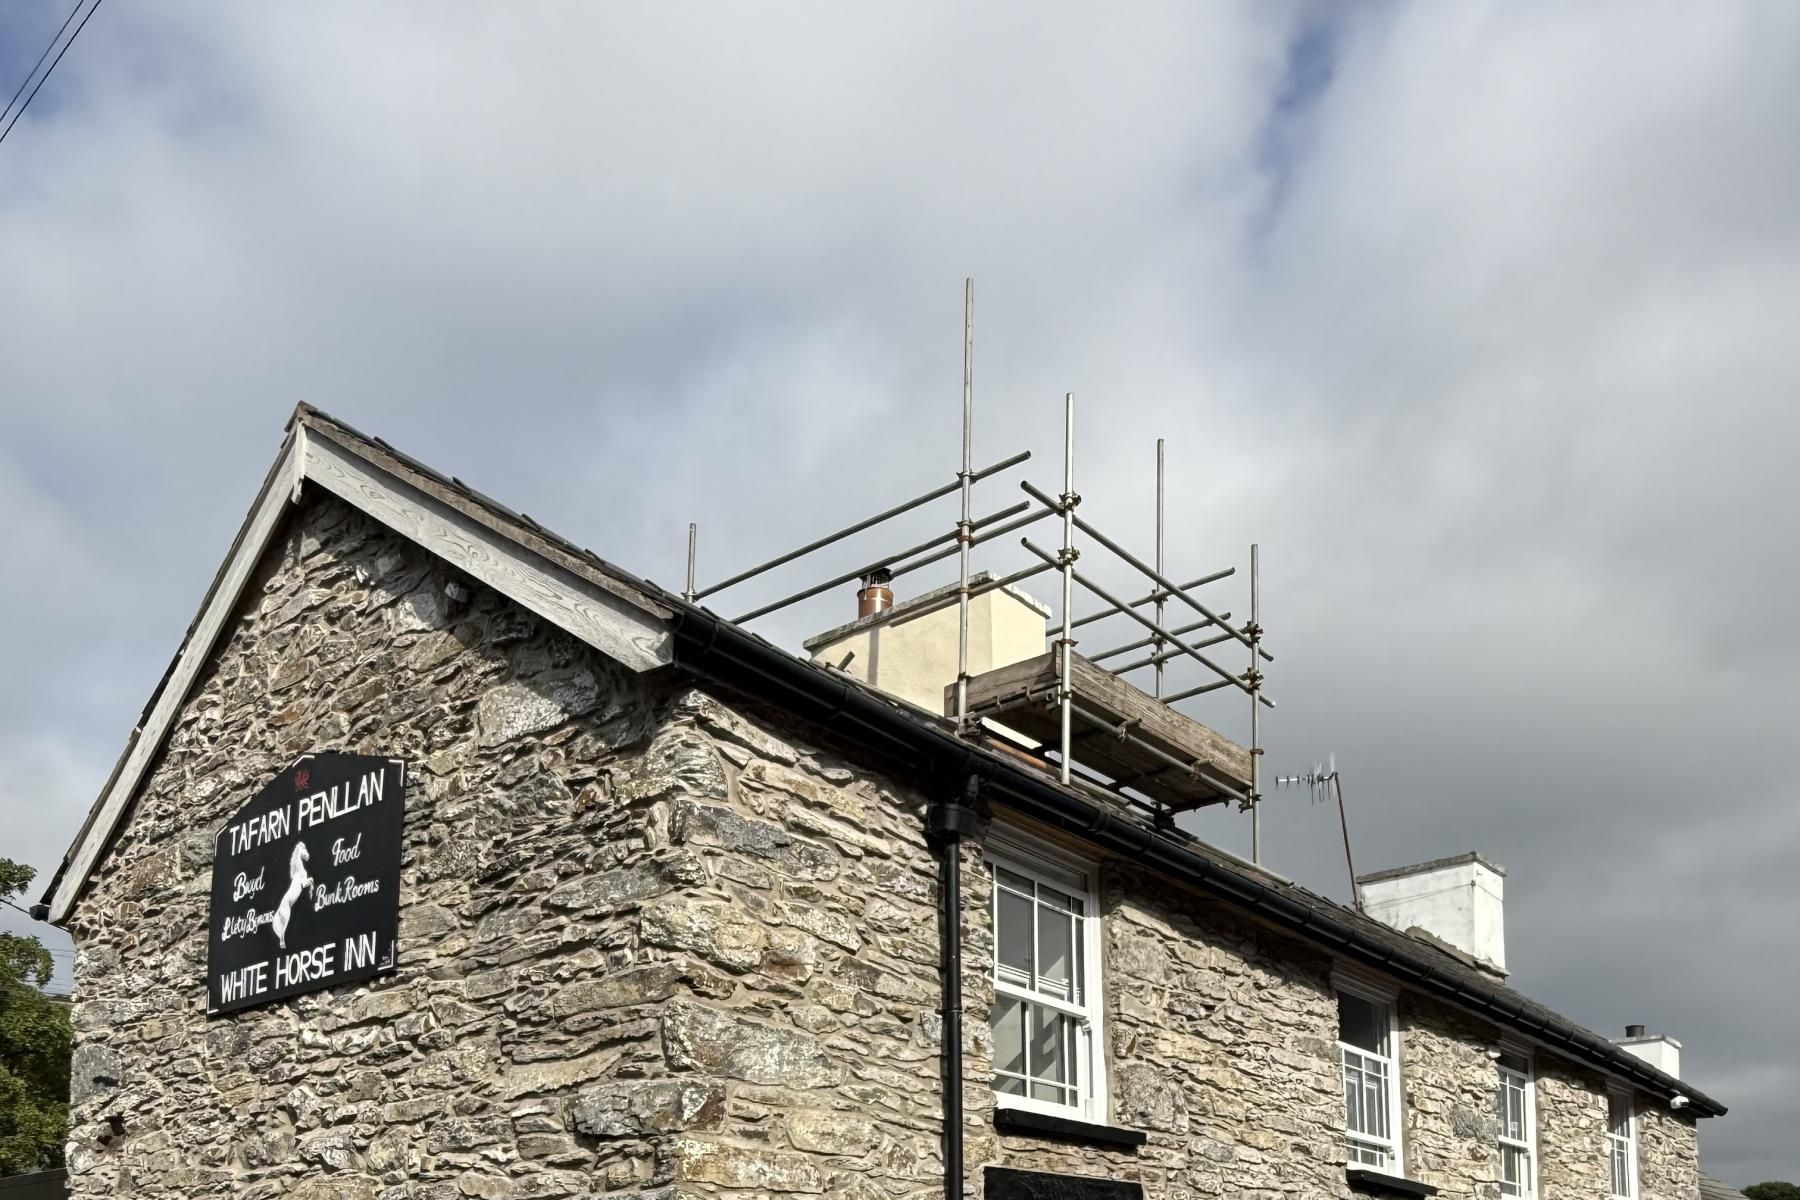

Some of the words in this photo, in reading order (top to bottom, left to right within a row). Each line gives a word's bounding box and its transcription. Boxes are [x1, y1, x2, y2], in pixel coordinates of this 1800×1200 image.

[230, 805, 290, 856] TAFARN
[298, 769, 384, 831] PENLLAN
[332, 832, 362, 866] Food
[314, 881, 342, 912] Bunk
[341, 876, 380, 903] Rooms
[221, 916, 246, 942] Llety
[221, 961, 268, 1004] WHITE
[276, 943, 335, 989] HORSE
[344, 931, 376, 971] INN
